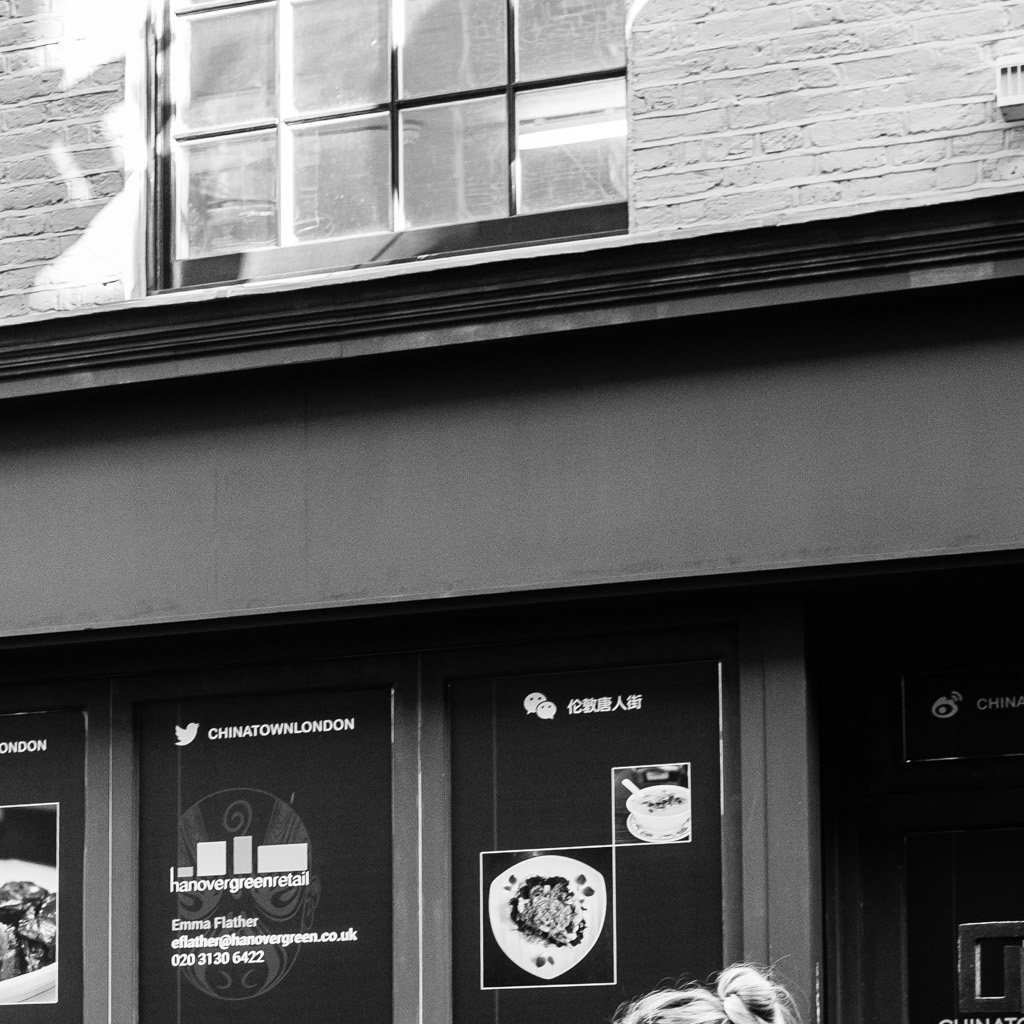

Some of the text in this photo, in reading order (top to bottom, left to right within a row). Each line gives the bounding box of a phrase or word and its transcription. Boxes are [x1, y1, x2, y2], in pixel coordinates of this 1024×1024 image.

[566, 694, 643, 715] 伦敦唐人街
[207, 717, 355, 740] CHINATOWNLONDON
[170, 866, 310, 894] hanovergreenretail
[171, 914, 259, 932] Emma Flather
[170, 927, 358, 950] eflather@hanovergreen.co.uk
[170, 949, 265, 967] 020 3130 6422
